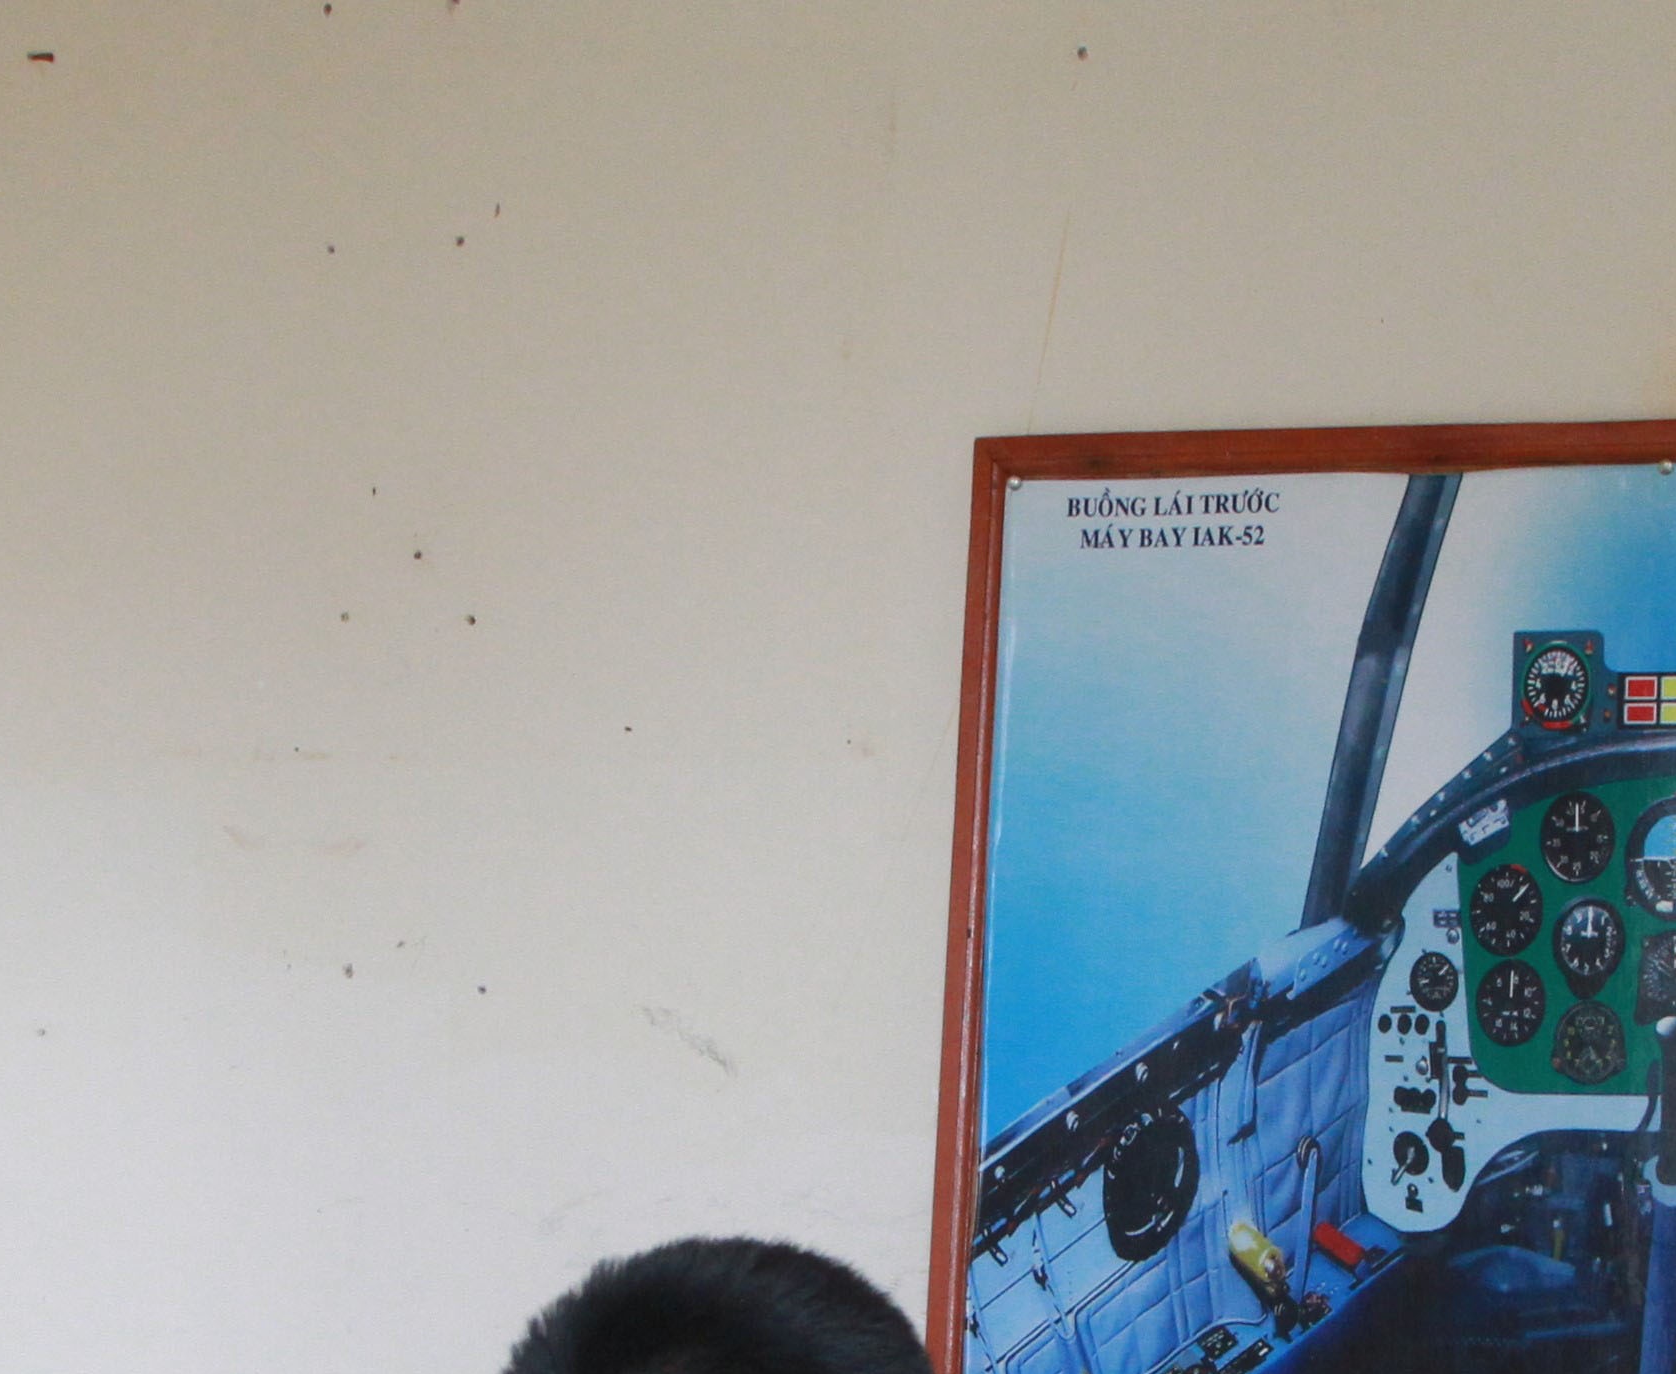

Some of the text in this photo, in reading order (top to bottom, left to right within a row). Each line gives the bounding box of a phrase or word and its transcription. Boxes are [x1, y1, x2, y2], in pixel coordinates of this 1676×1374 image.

[1067, 487, 1280, 518] BUỒNG LÁI TRƯỚC
[1080, 523, 1265, 549] MÁY BAY IAK-52
